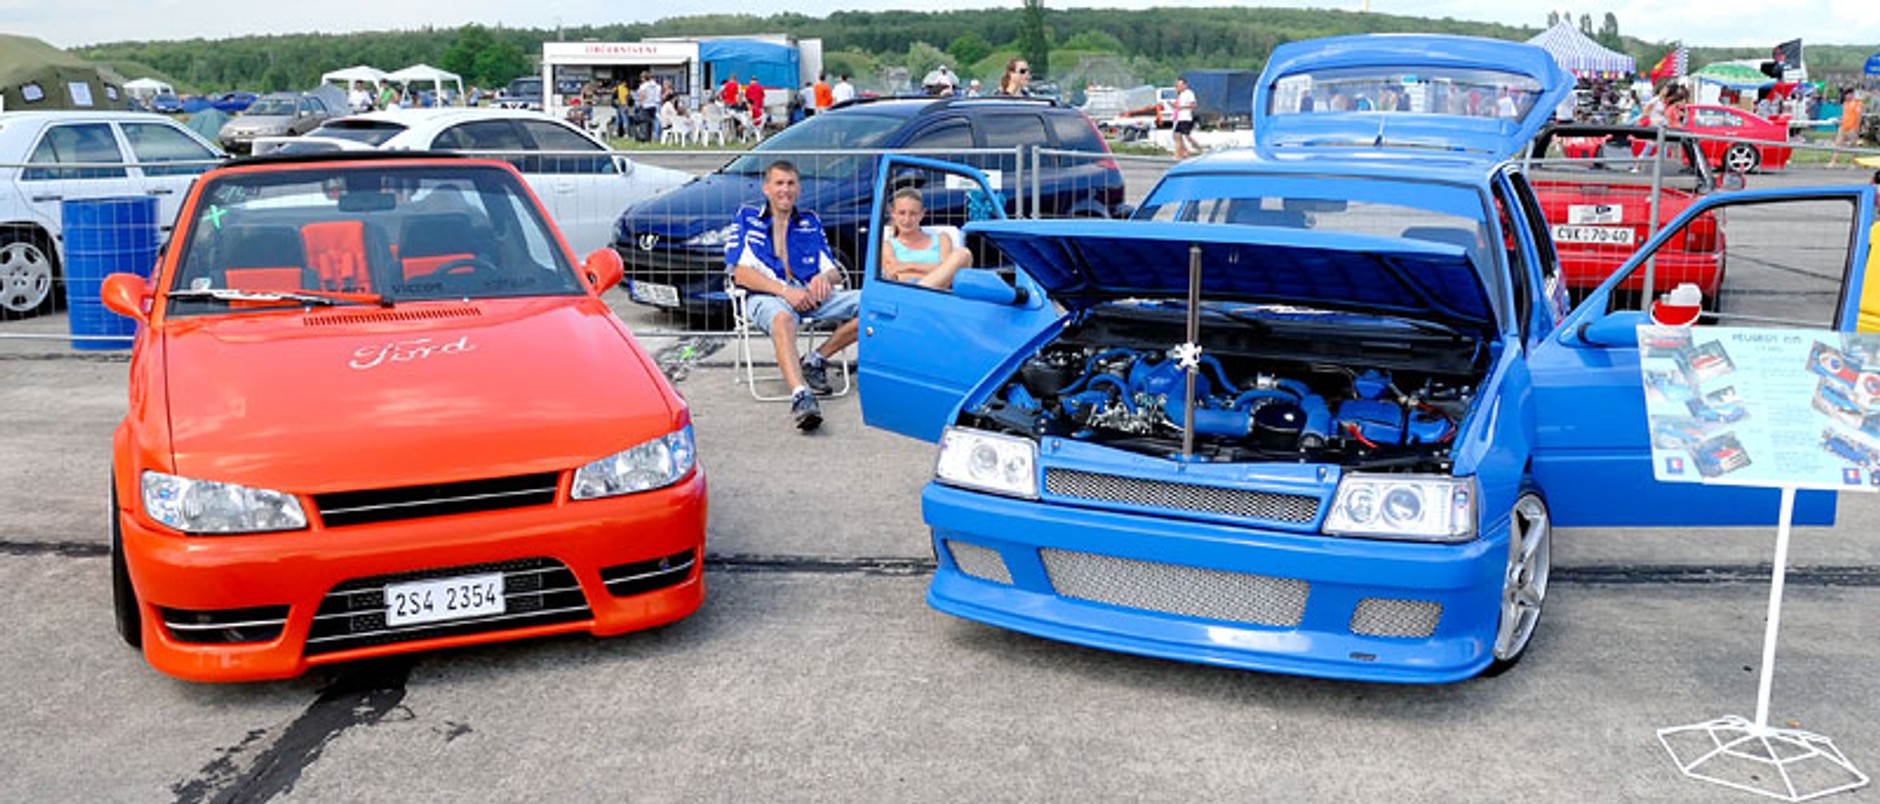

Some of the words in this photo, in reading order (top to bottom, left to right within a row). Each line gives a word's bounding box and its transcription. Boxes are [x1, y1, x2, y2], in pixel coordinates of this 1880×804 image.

[348, 332, 477, 370] Ford
[395, 590, 434, 617] 2S4
[446, 583, 496, 610] 2354
